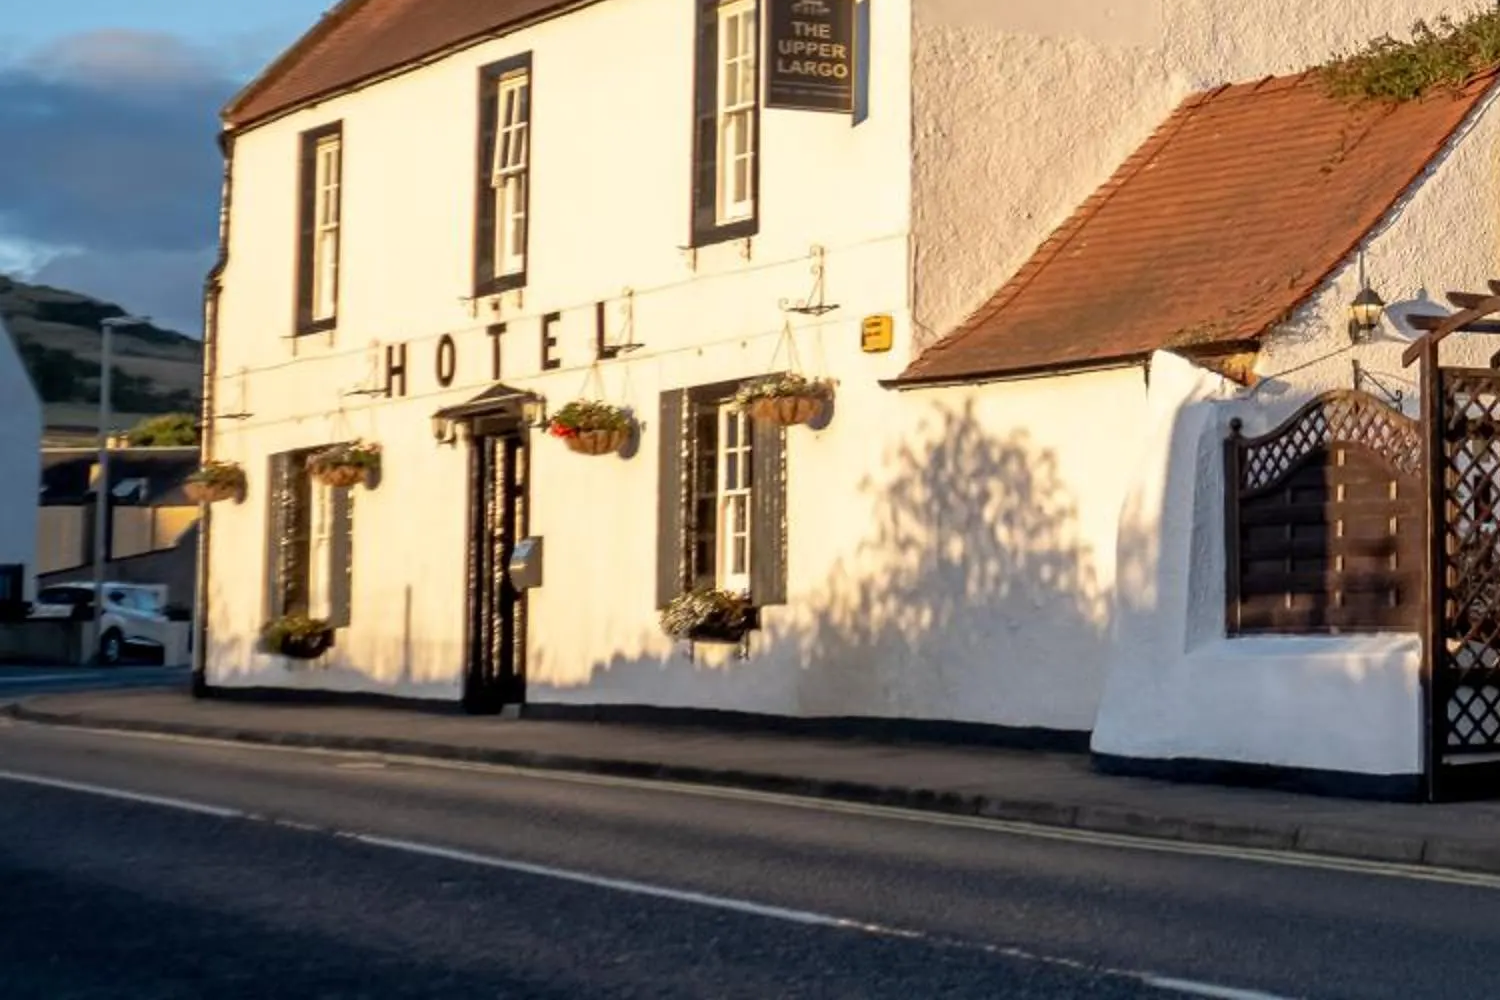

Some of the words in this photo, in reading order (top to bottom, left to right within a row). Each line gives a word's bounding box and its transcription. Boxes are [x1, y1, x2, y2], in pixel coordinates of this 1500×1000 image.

[791, 21, 831, 39] THE
[778, 40, 847, 60] UPPER
[777, 58, 849, 79] LARGO
[386, 301, 618, 398] HOTEL
